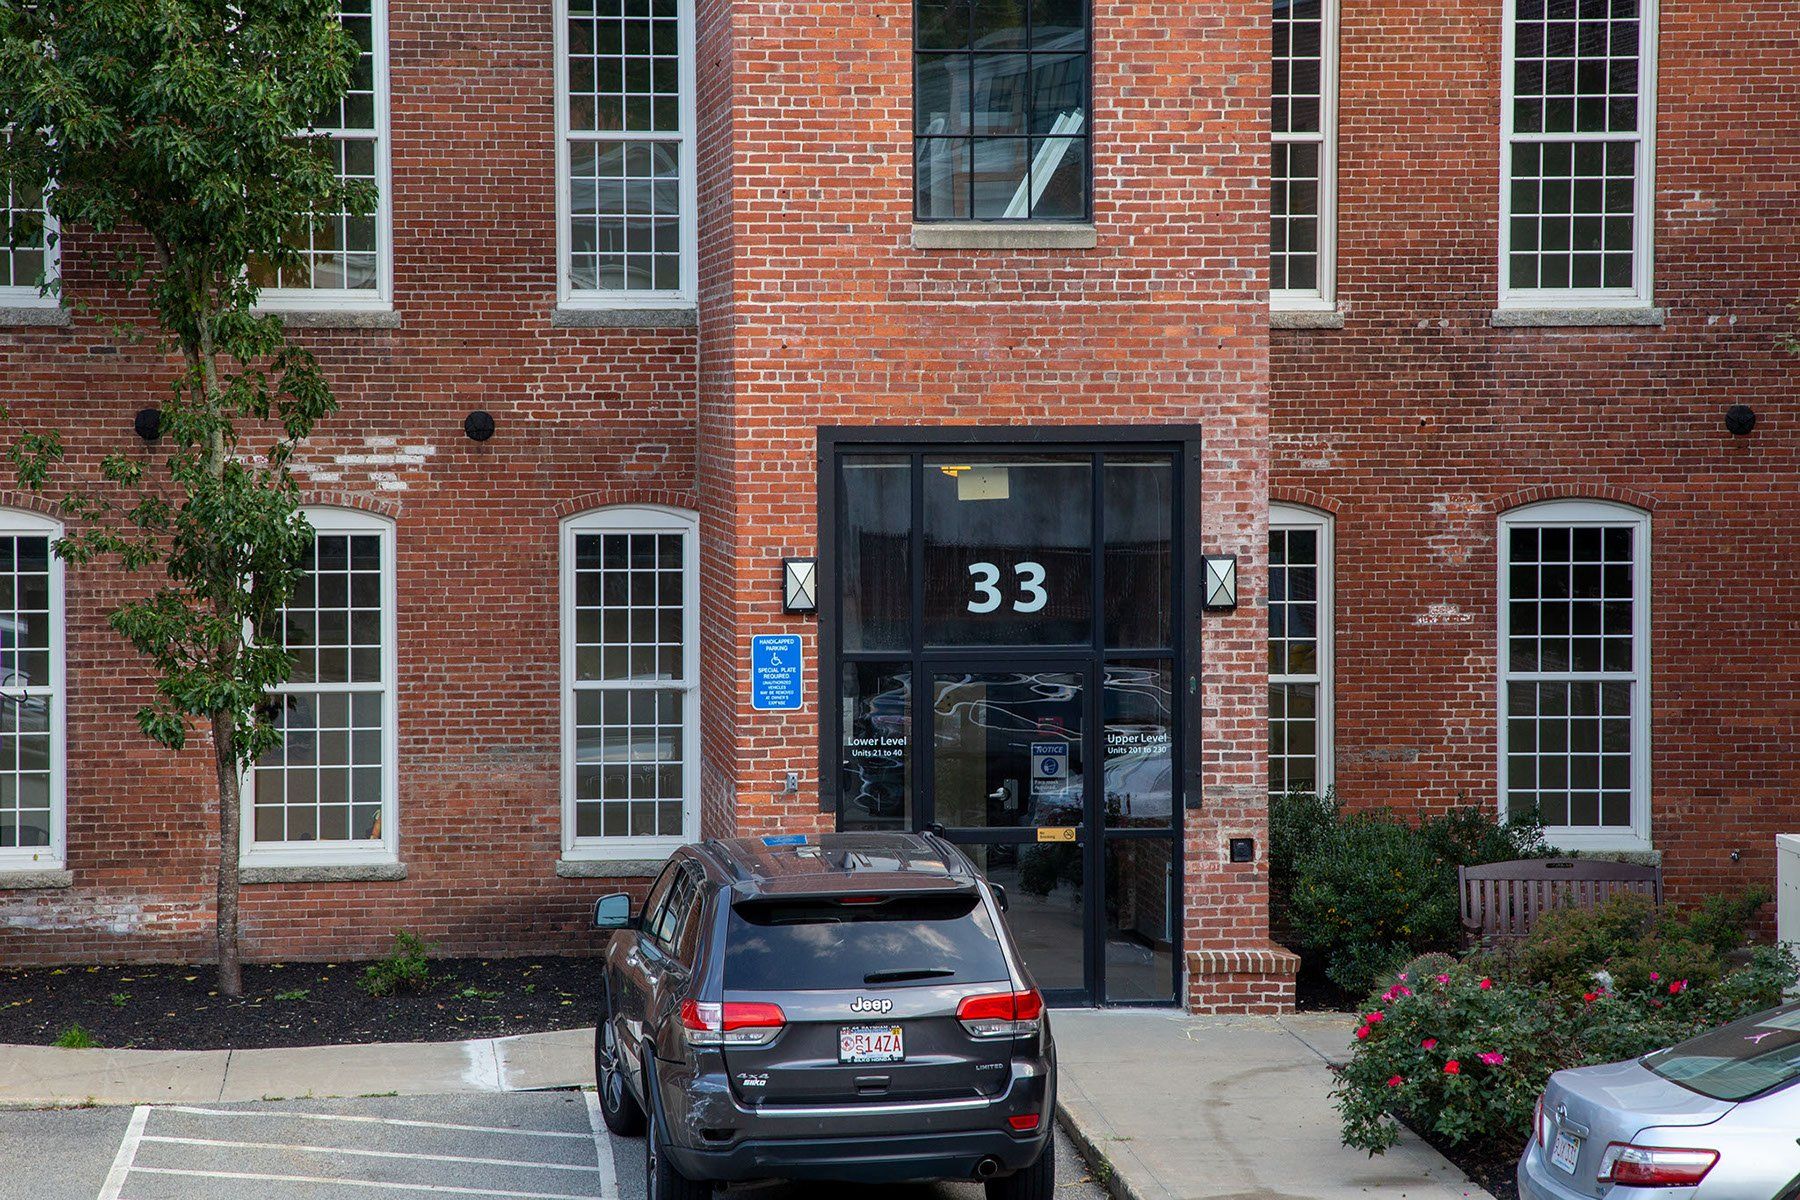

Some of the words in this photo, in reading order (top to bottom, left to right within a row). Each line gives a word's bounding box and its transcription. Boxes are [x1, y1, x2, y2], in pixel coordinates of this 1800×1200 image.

[967, 561, 1048, 614] 33
[847, 736, 879, 746] Lower
[880, 736, 907, 746] Level
[1107, 733, 1139, 745] Upper
[1140, 733, 1167, 743] Level
[851, 749, 871, 757] Units
[872, 749, 882, 757] 21
[1036, 745, 1064, 754] NOTICE
[1107, 746, 1127, 754] Units
[1128, 746, 1142, 754] 201
[850, 996, 894, 1014] Jeep
